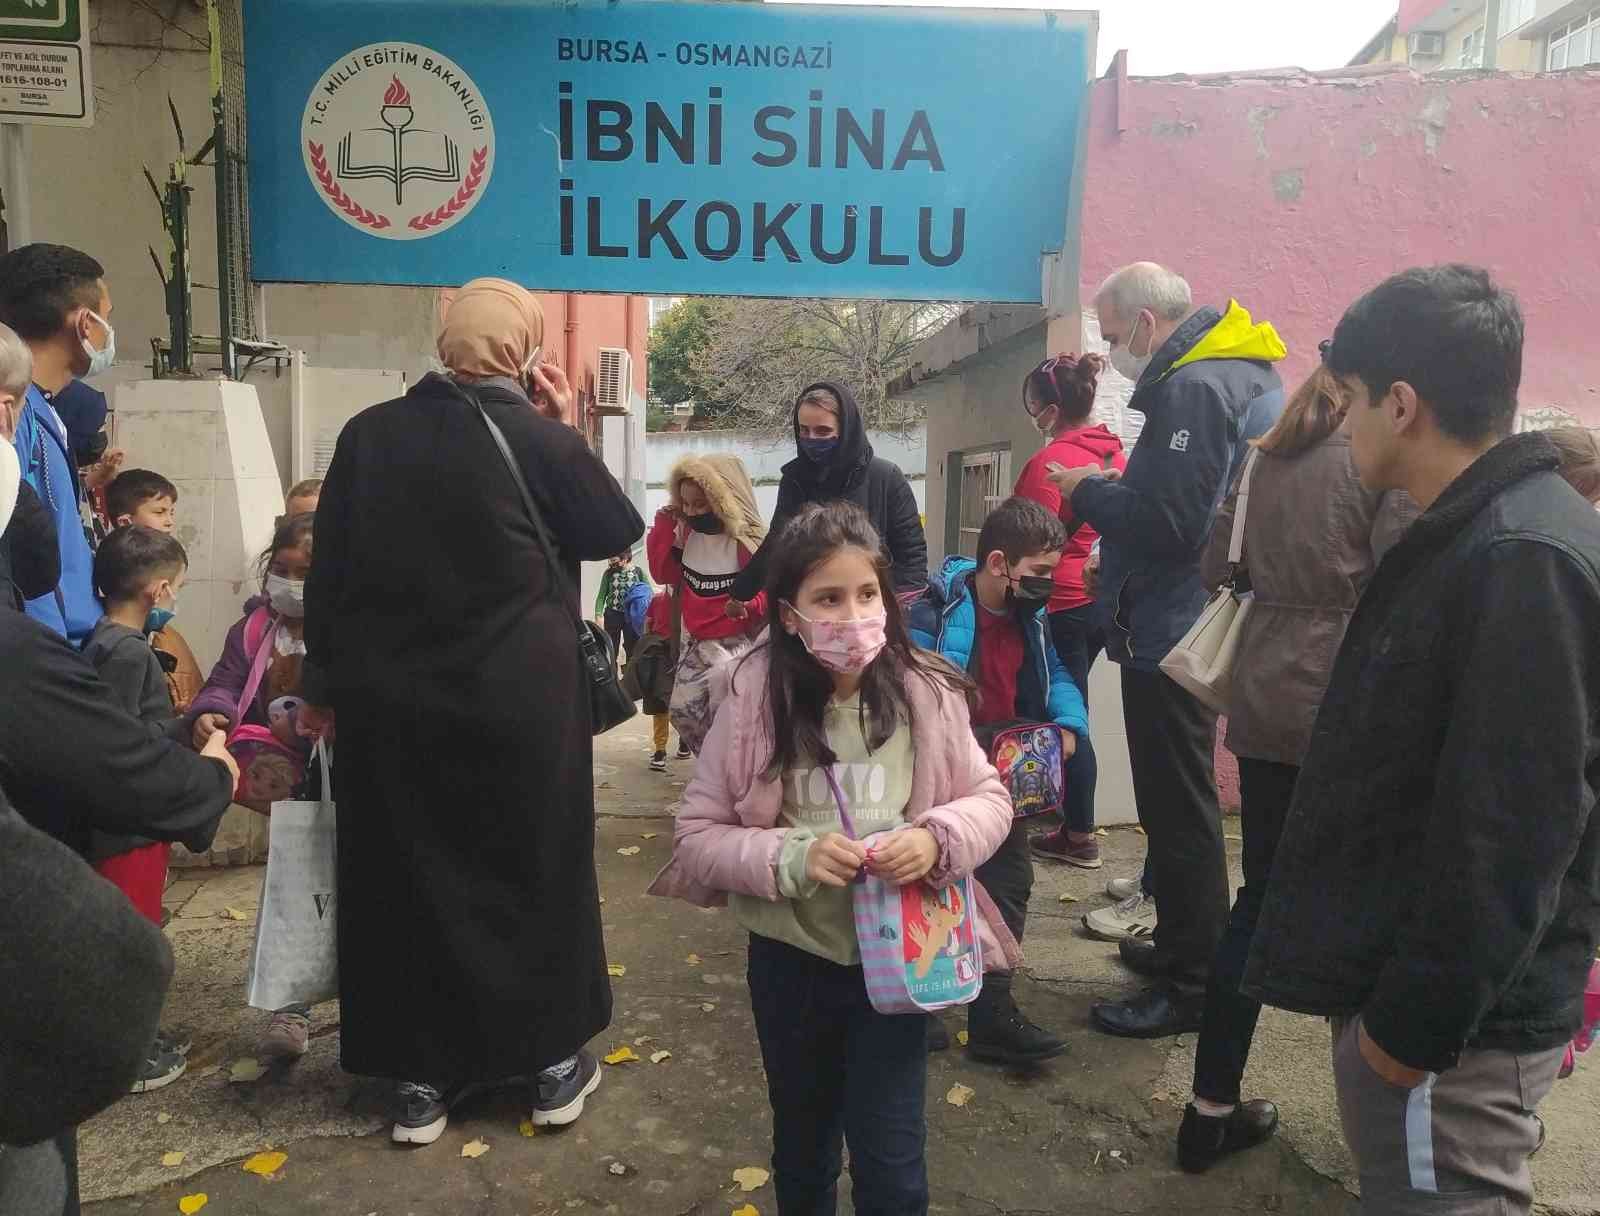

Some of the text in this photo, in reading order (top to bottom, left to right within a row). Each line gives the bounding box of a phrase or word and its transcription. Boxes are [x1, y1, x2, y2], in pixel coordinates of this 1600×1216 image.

[2, 63, 40, 72] TOPLANMA
[41, 55, 68, 63] DURUM
[557, 38, 648, 64] BURSA
[676, 41, 832, 69] OSMANGAZİ
[310, 99, 331, 126] T.C.
[363, 48, 419, 68] EĞİTİM
[422, 57, 484, 131] BAKANLIĞI
[559, 81, 945, 172] İBNİ SİNA
[559, 179, 966, 267] İLKOKULU
[791, 762, 886, 806] TOKYO
